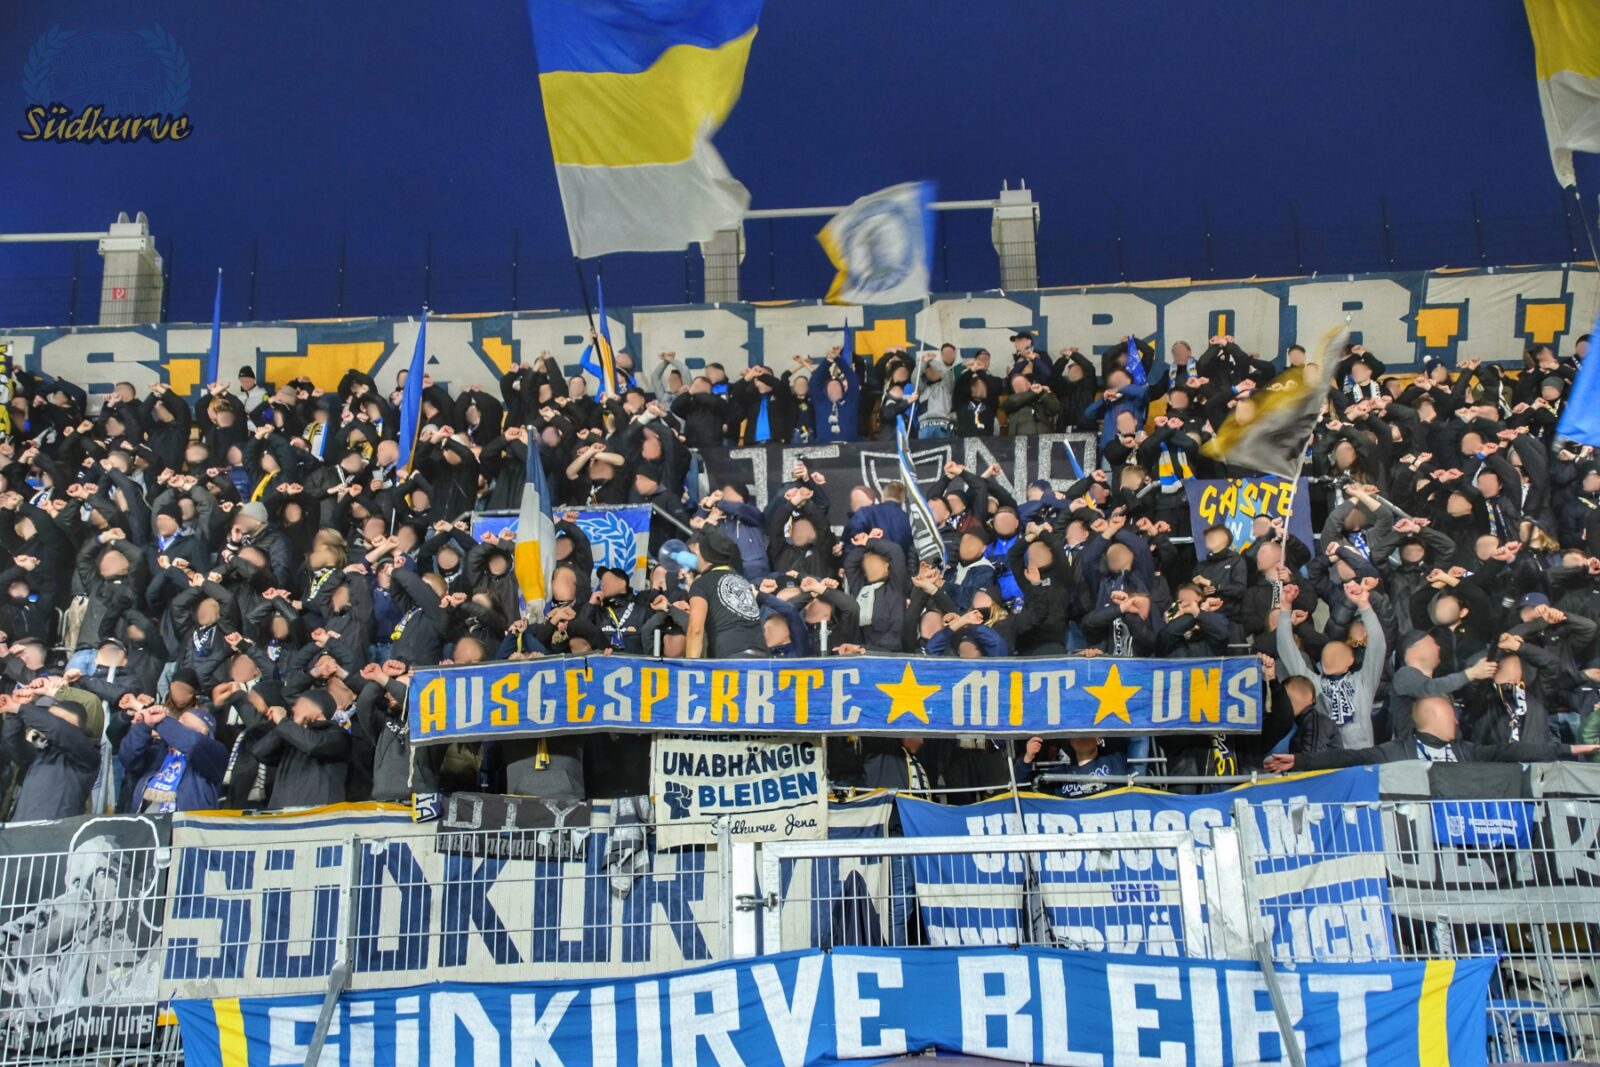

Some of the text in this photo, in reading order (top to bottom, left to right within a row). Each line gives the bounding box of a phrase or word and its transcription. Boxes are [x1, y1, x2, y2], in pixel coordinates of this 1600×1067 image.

[0, 327, 298, 403] ST
[915, 270, 1600, 368] SPORT
[1199, 478, 1297, 526] GÄSTE
[419, 665, 1259, 734] AUSGESPERRTE MIT UNS
[662, 741, 816, 778] UNABHÄNGIG
[698, 771, 818, 808] BLEIBEN
[443, 791, 588, 834] DIY
[784, 813, 818, 836] Jena
[1110, 883, 1161, 904] UND
[76, 1015, 112, 1037] MIT
[118, 1014, 153, 1036] UNS
[268, 952, 1393, 1067] SÜDKURVE BLEIBT
